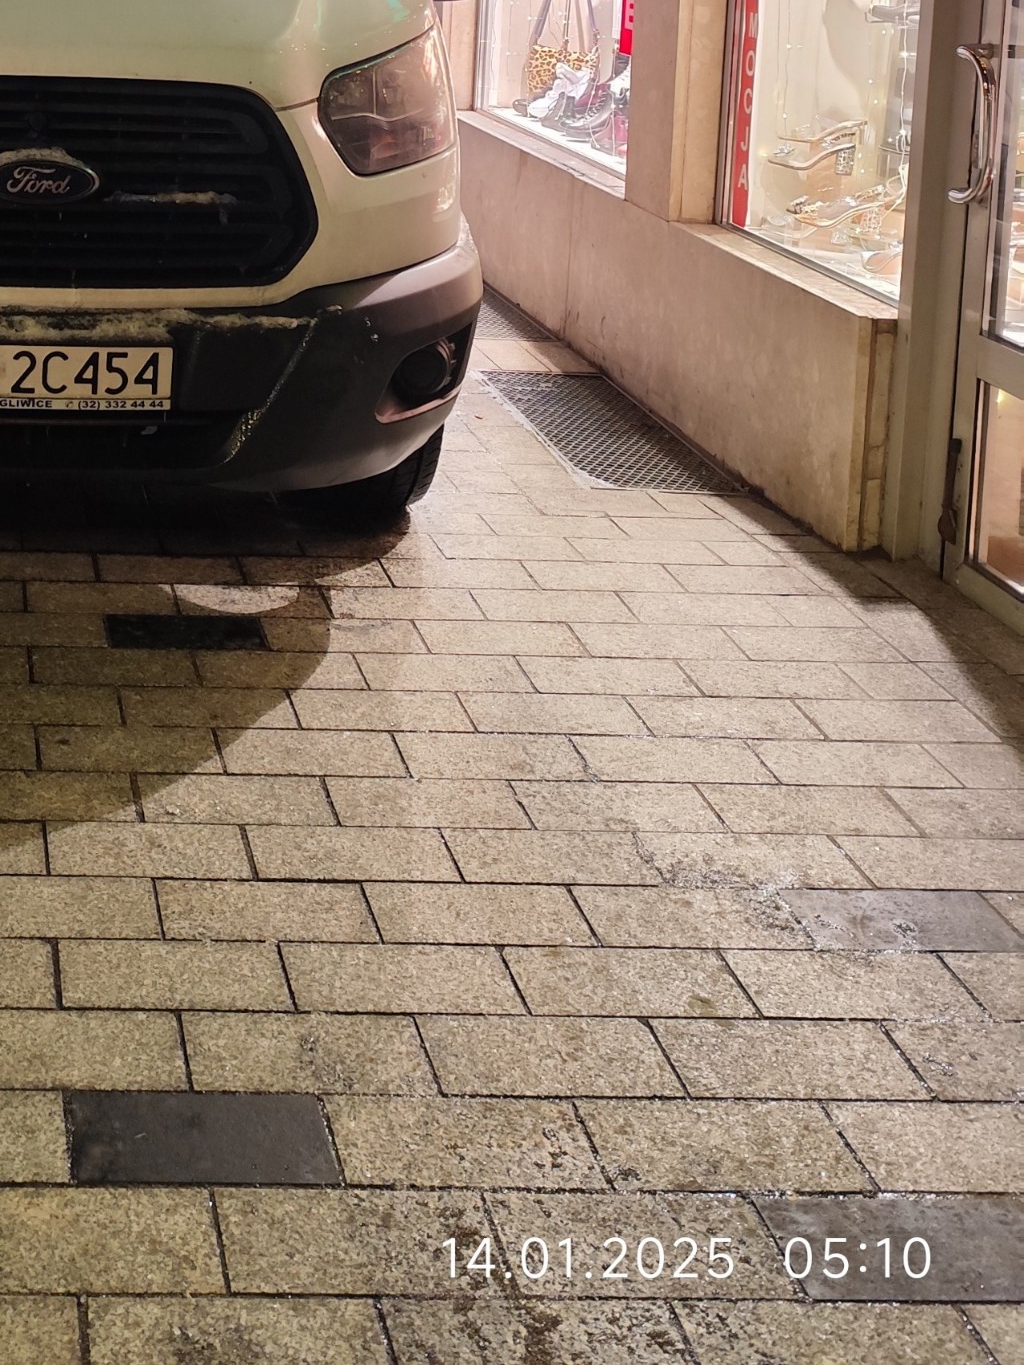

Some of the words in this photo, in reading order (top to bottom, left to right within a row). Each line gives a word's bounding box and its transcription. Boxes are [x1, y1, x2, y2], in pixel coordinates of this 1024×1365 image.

[6, 166, 71, 193] Ford
[11, 350, 160, 395] 2C454
[0, 398, 53, 408] GLIWICE
[77, 399, 101, 410] (32)
[105, 400, 126, 410] 332
[130, 400, 146, 409] 44
[149, 400, 164, 409] 44
